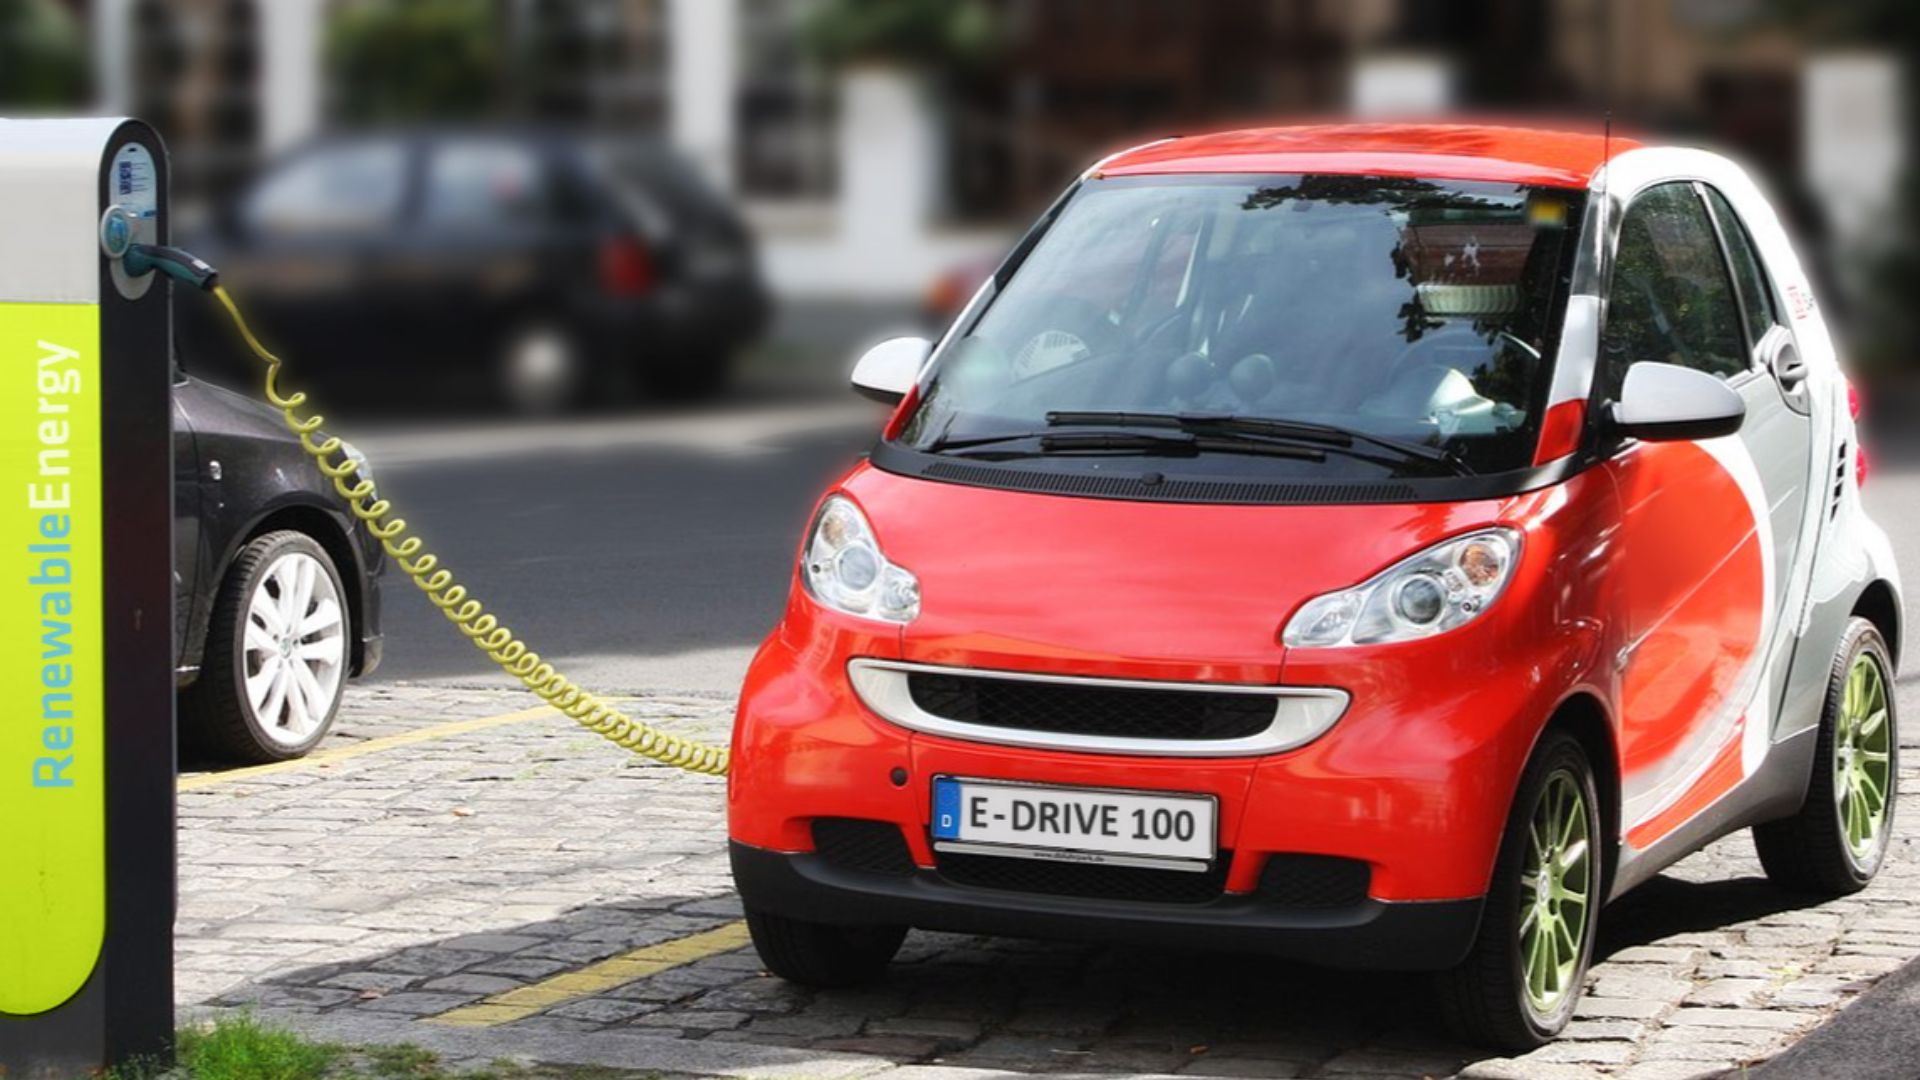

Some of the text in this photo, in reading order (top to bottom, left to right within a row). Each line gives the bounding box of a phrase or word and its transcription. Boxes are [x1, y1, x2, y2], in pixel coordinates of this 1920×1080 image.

[941, 814, 952, 827] D
[970, 796, 1195, 842] E-DRIVE 100
